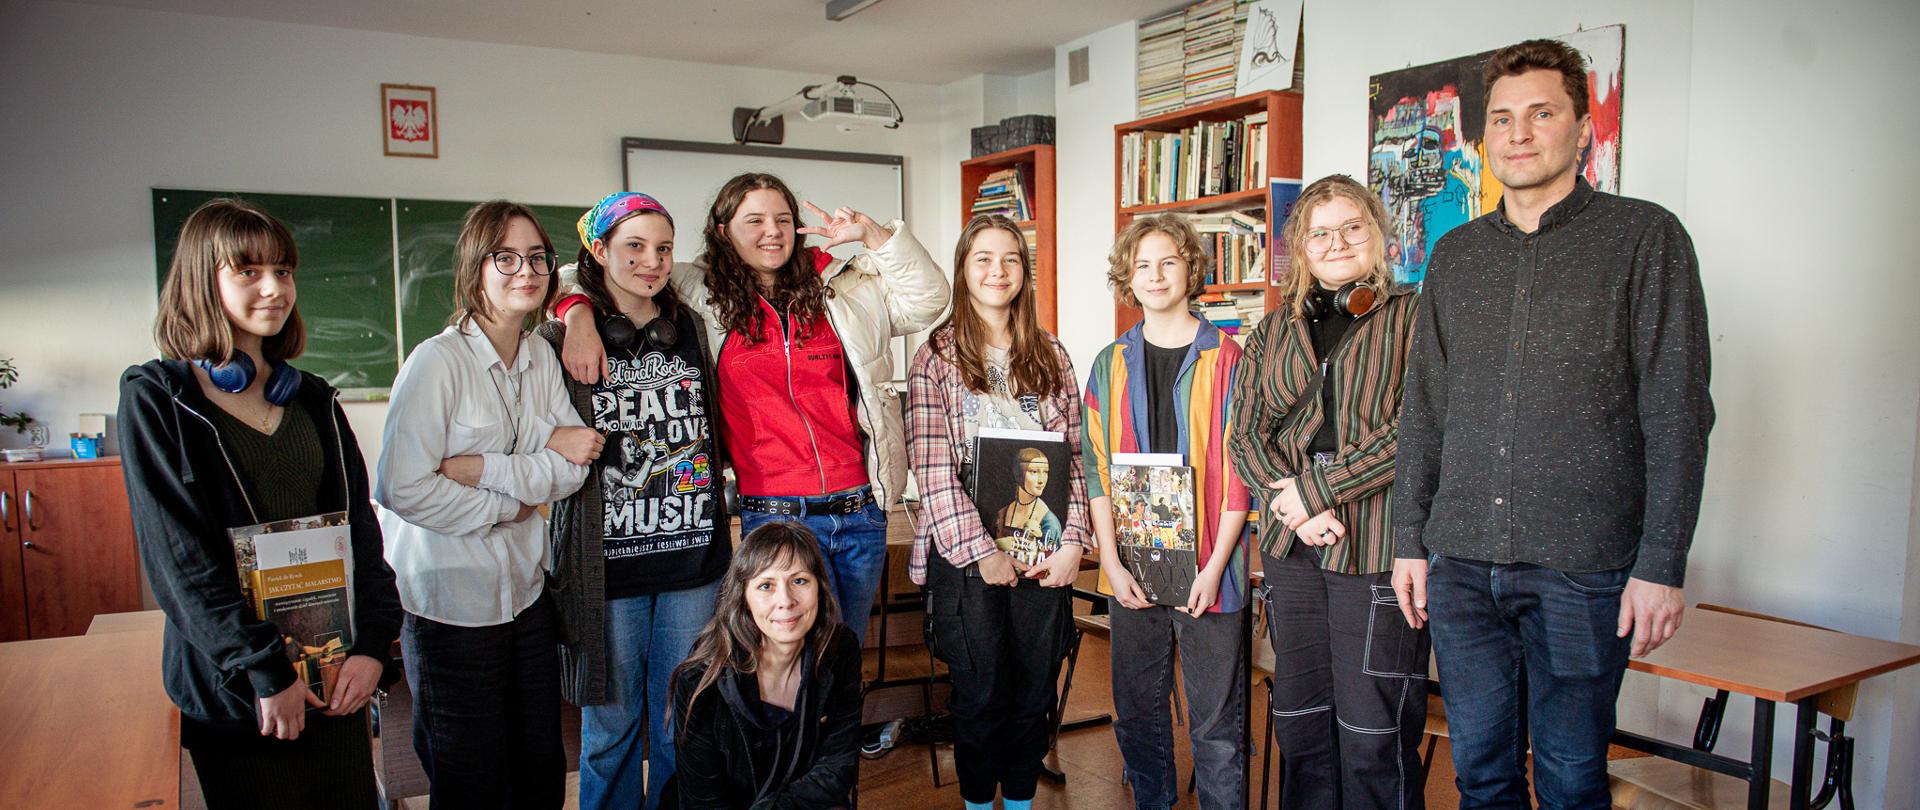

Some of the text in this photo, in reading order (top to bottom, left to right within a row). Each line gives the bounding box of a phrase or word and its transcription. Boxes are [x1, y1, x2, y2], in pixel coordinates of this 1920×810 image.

[592, 380, 705, 428] PEACE
[603, 419, 645, 431] NO WAR
[648, 416, 709, 443] LOVE
[673, 453, 712, 496] 28
[602, 492, 713, 537] MUSIC
